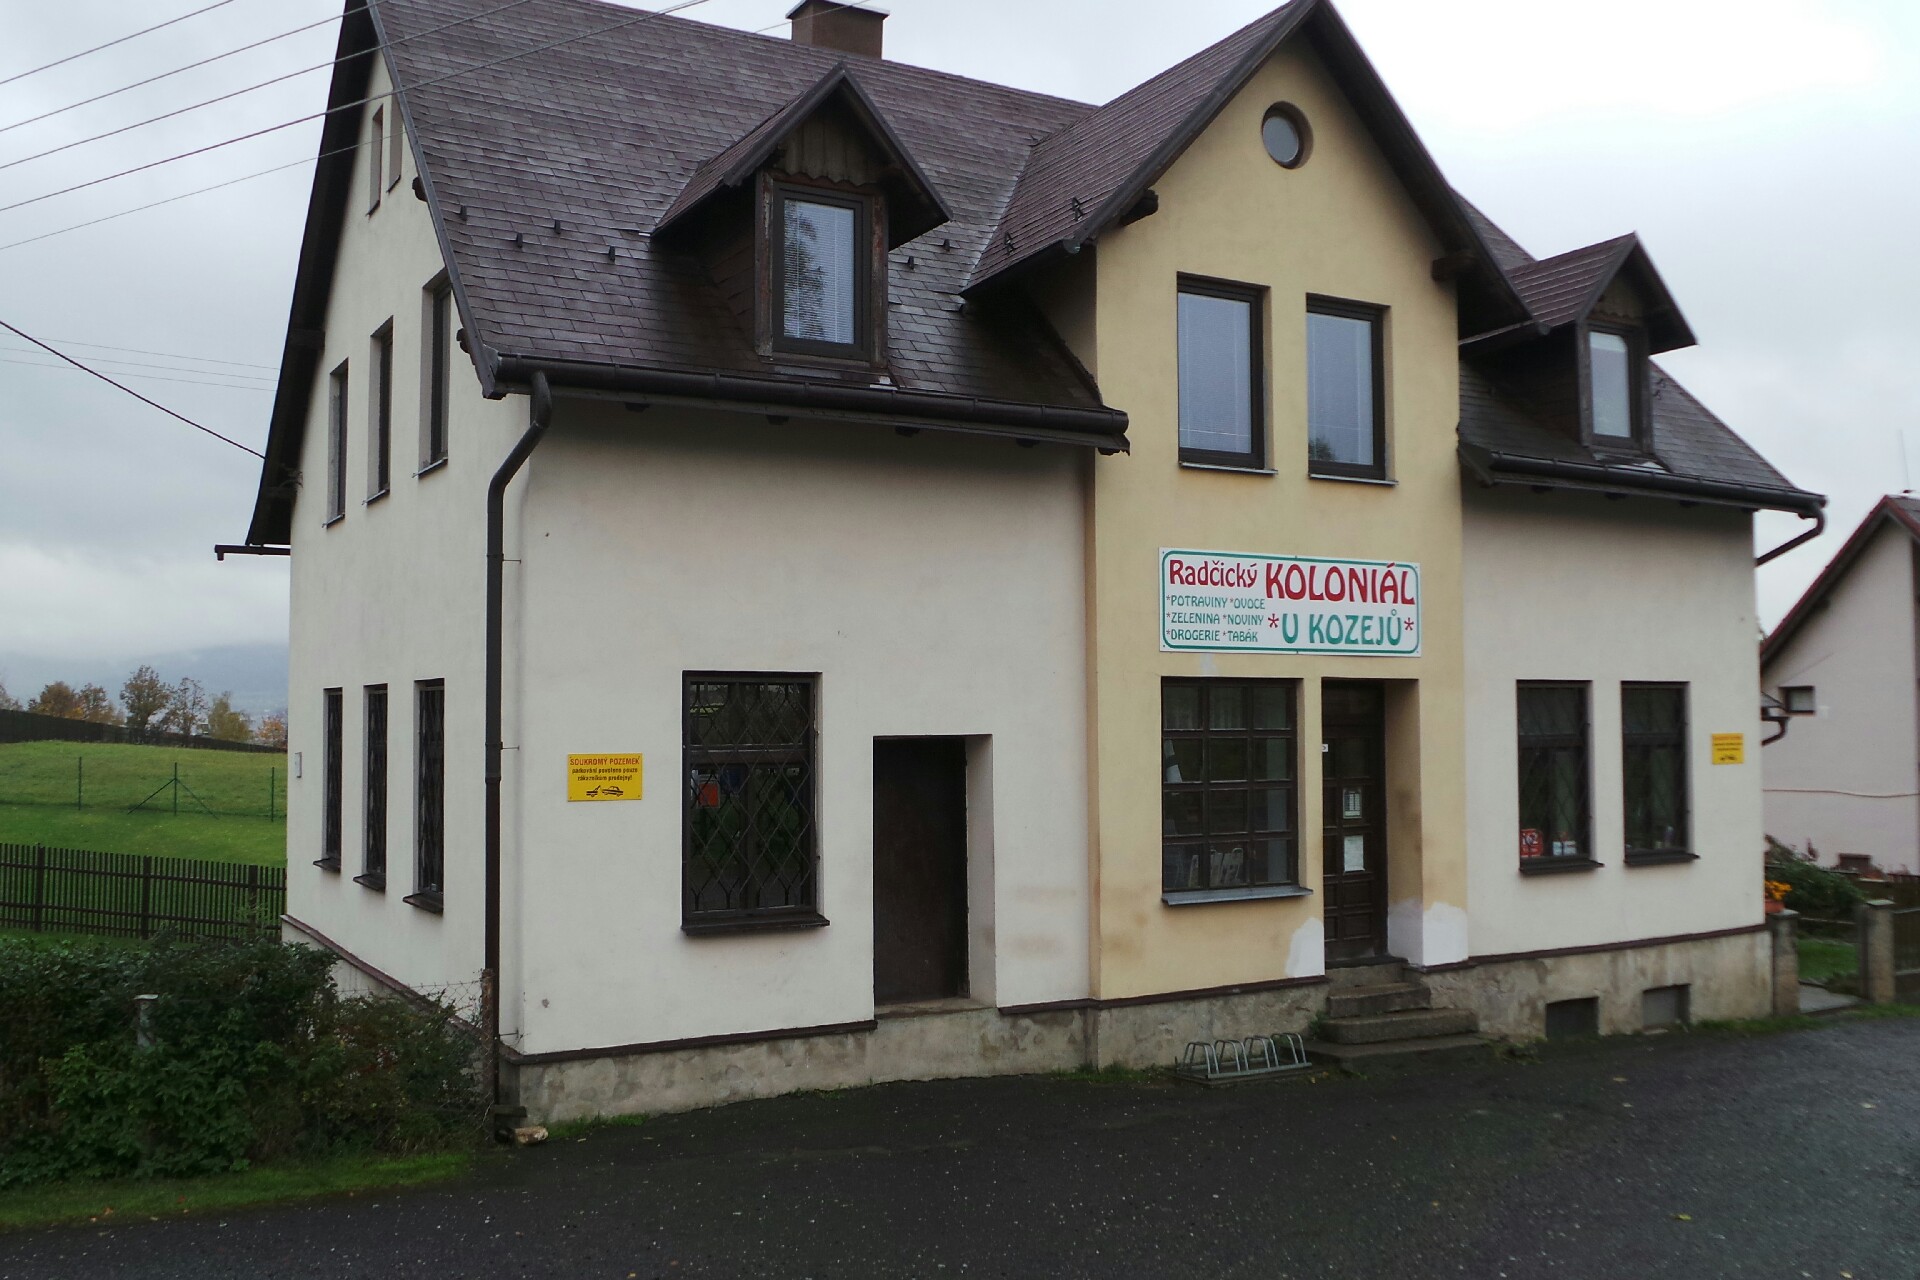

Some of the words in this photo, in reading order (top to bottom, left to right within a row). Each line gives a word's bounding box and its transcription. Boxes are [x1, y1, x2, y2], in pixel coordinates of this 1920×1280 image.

[1170, 559, 1258, 588] Radčický
[1265, 562, 1415, 605] KOLONIÁL
[1171, 595, 1228, 608] POTRAVINY
[1234, 598, 1265, 609] OVOCE
[1171, 612, 1220, 624] ZELENINA
[1227, 614, 1264, 625] NOVINY
[1282, 613, 1299, 644] U
[1309, 609, 1402, 645] KOZEJŮ
[1170, 629, 1220, 641] DROGERIE
[1227, 629, 1258, 642] TABÁK
[610, 757, 640, 766] POZEMEK
